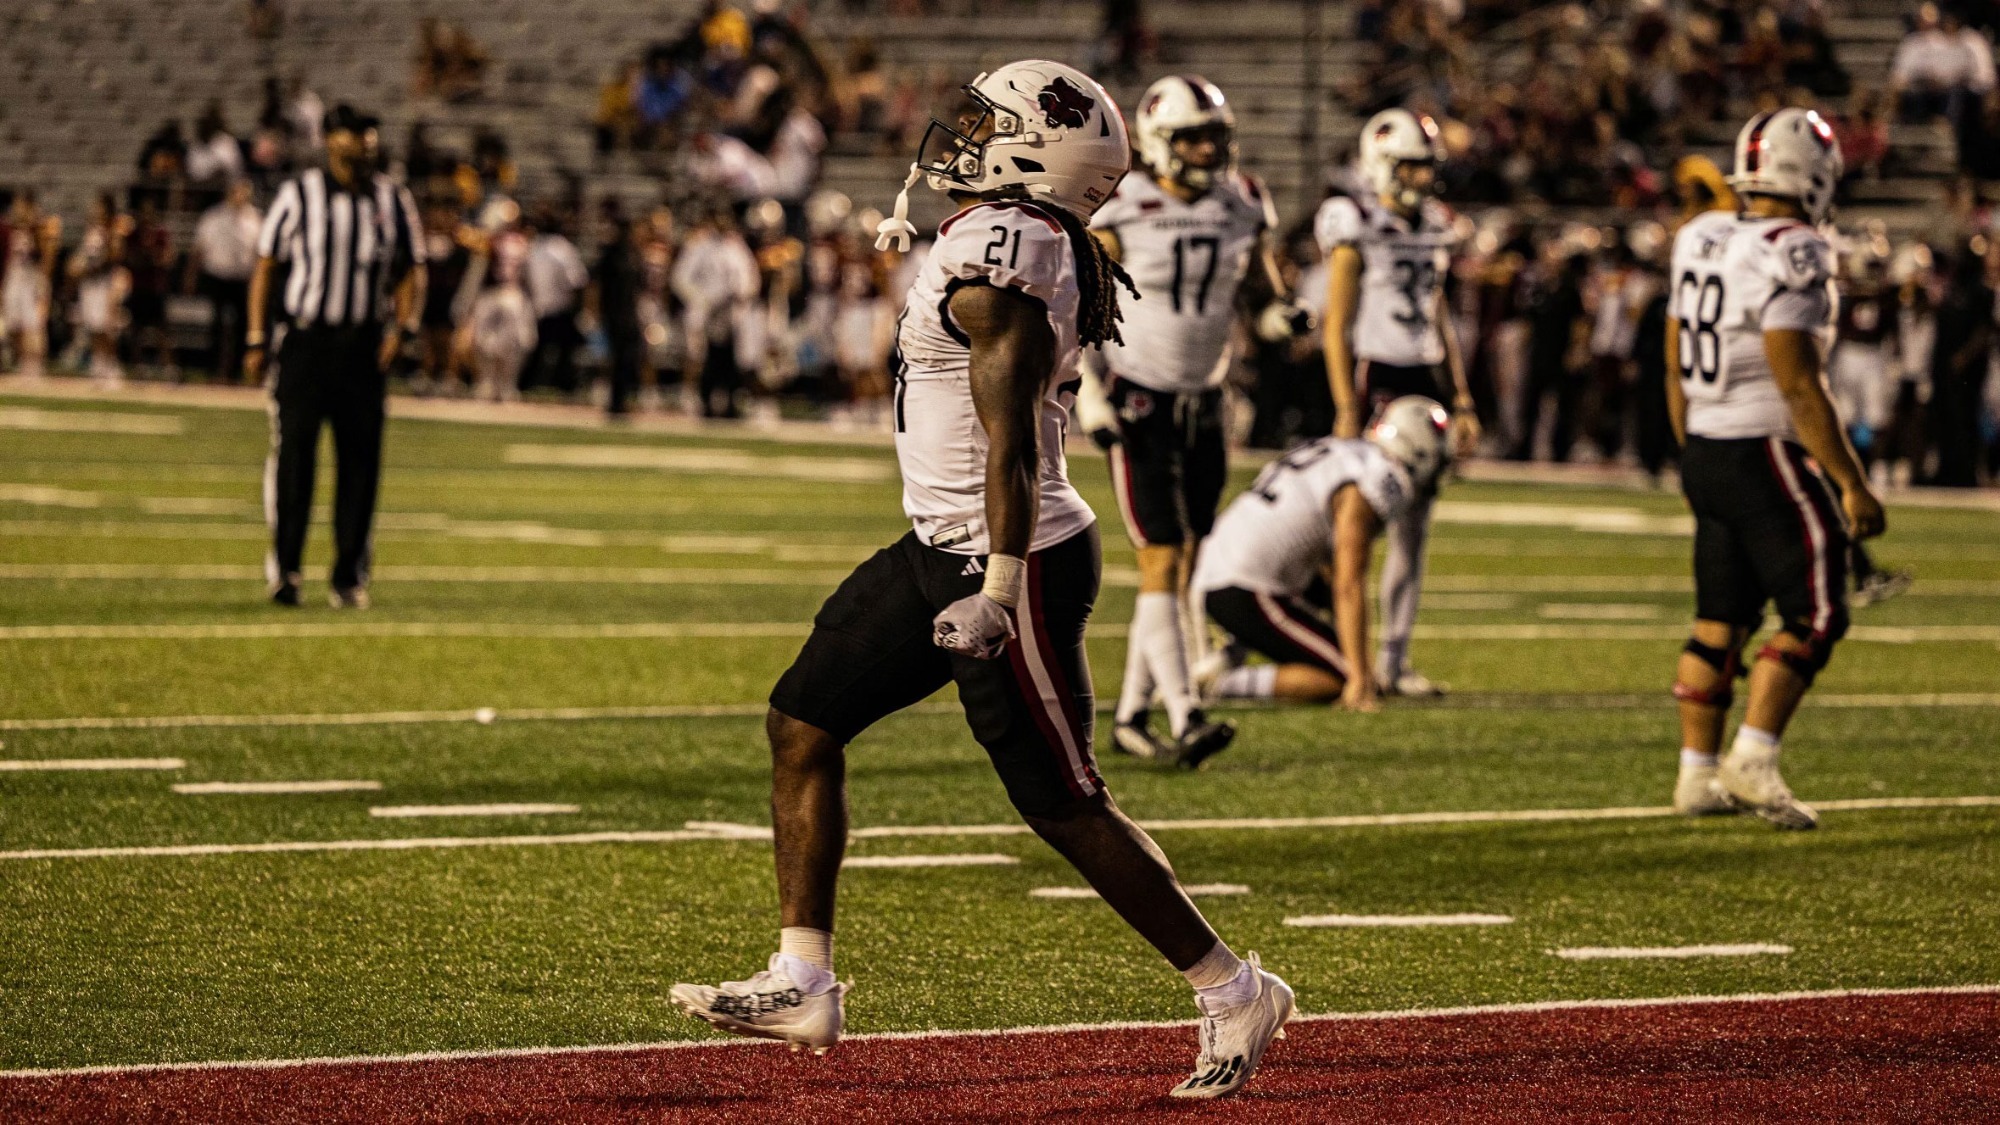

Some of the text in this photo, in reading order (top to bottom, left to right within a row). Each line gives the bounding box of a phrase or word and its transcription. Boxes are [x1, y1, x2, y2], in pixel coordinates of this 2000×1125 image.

[983, 225, 1022, 270] 21
[1173, 234, 1220, 314] 17
[1677, 270, 1723, 383] 68
